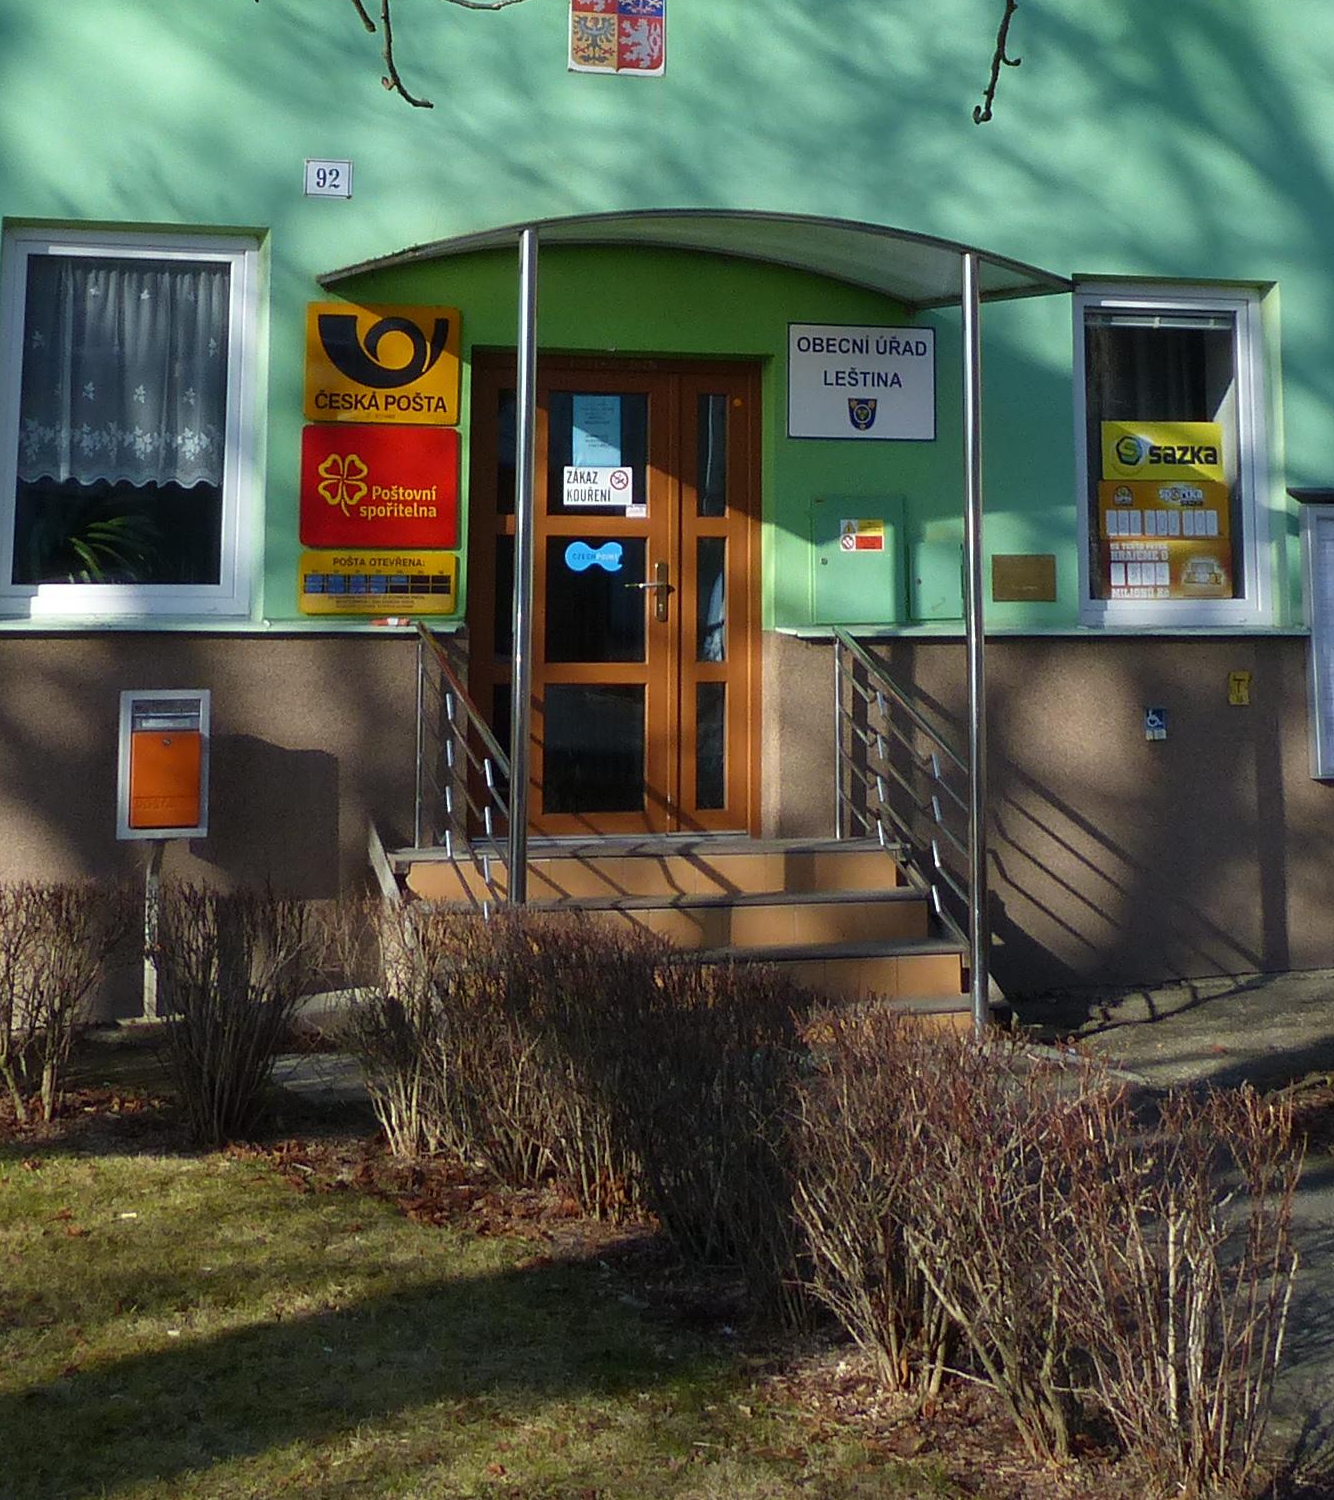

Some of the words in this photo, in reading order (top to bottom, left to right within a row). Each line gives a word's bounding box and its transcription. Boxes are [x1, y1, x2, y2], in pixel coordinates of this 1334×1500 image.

[316, 167, 341, 189] 92
[797, 334, 870, 355] OBECNÍ
[875, 335, 928, 357] ÚŘAD
[823, 366, 903, 389] LEŠTINA
[314, 389, 380, 411] ČESKÁ
[384, 392, 448, 413] POŠTA
[566, 468, 599, 485] ZÁKAZ
[371, 485, 437, 501] Poštovní
[566, 486, 612, 503] KOUŘENÍ
[359, 502, 438, 521] spořitelna
[332, 555, 366, 567] POŠTA
[369, 556, 426, 568] OTEVŘENA:
